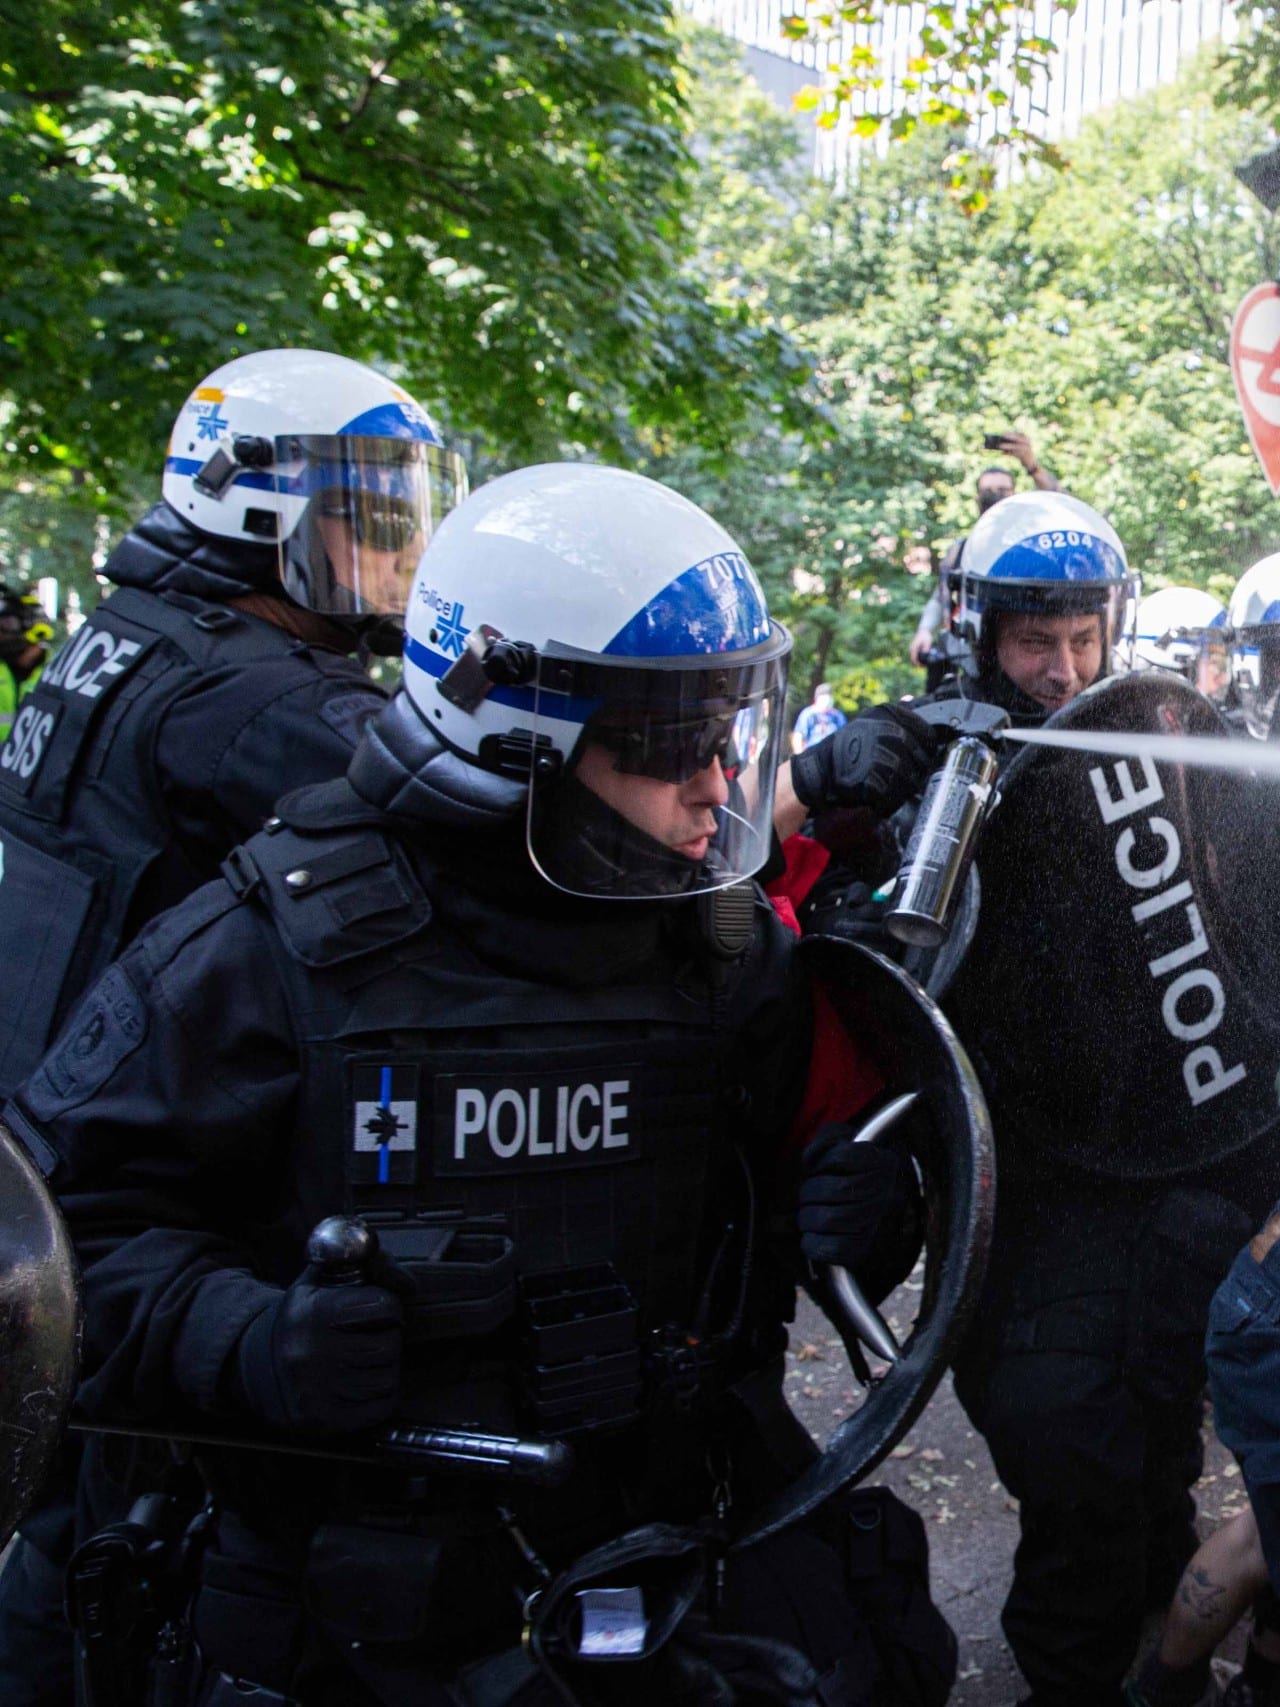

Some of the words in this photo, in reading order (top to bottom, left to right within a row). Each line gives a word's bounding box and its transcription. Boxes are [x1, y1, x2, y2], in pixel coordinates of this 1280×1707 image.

[1038, 531, 1093, 550] 6204
[42, 626, 142, 698] LICE
[1, 706, 54, 778] SIS
[1088, 752, 1248, 1107] POLICE
[454, 1080, 630, 1159] POLICE
